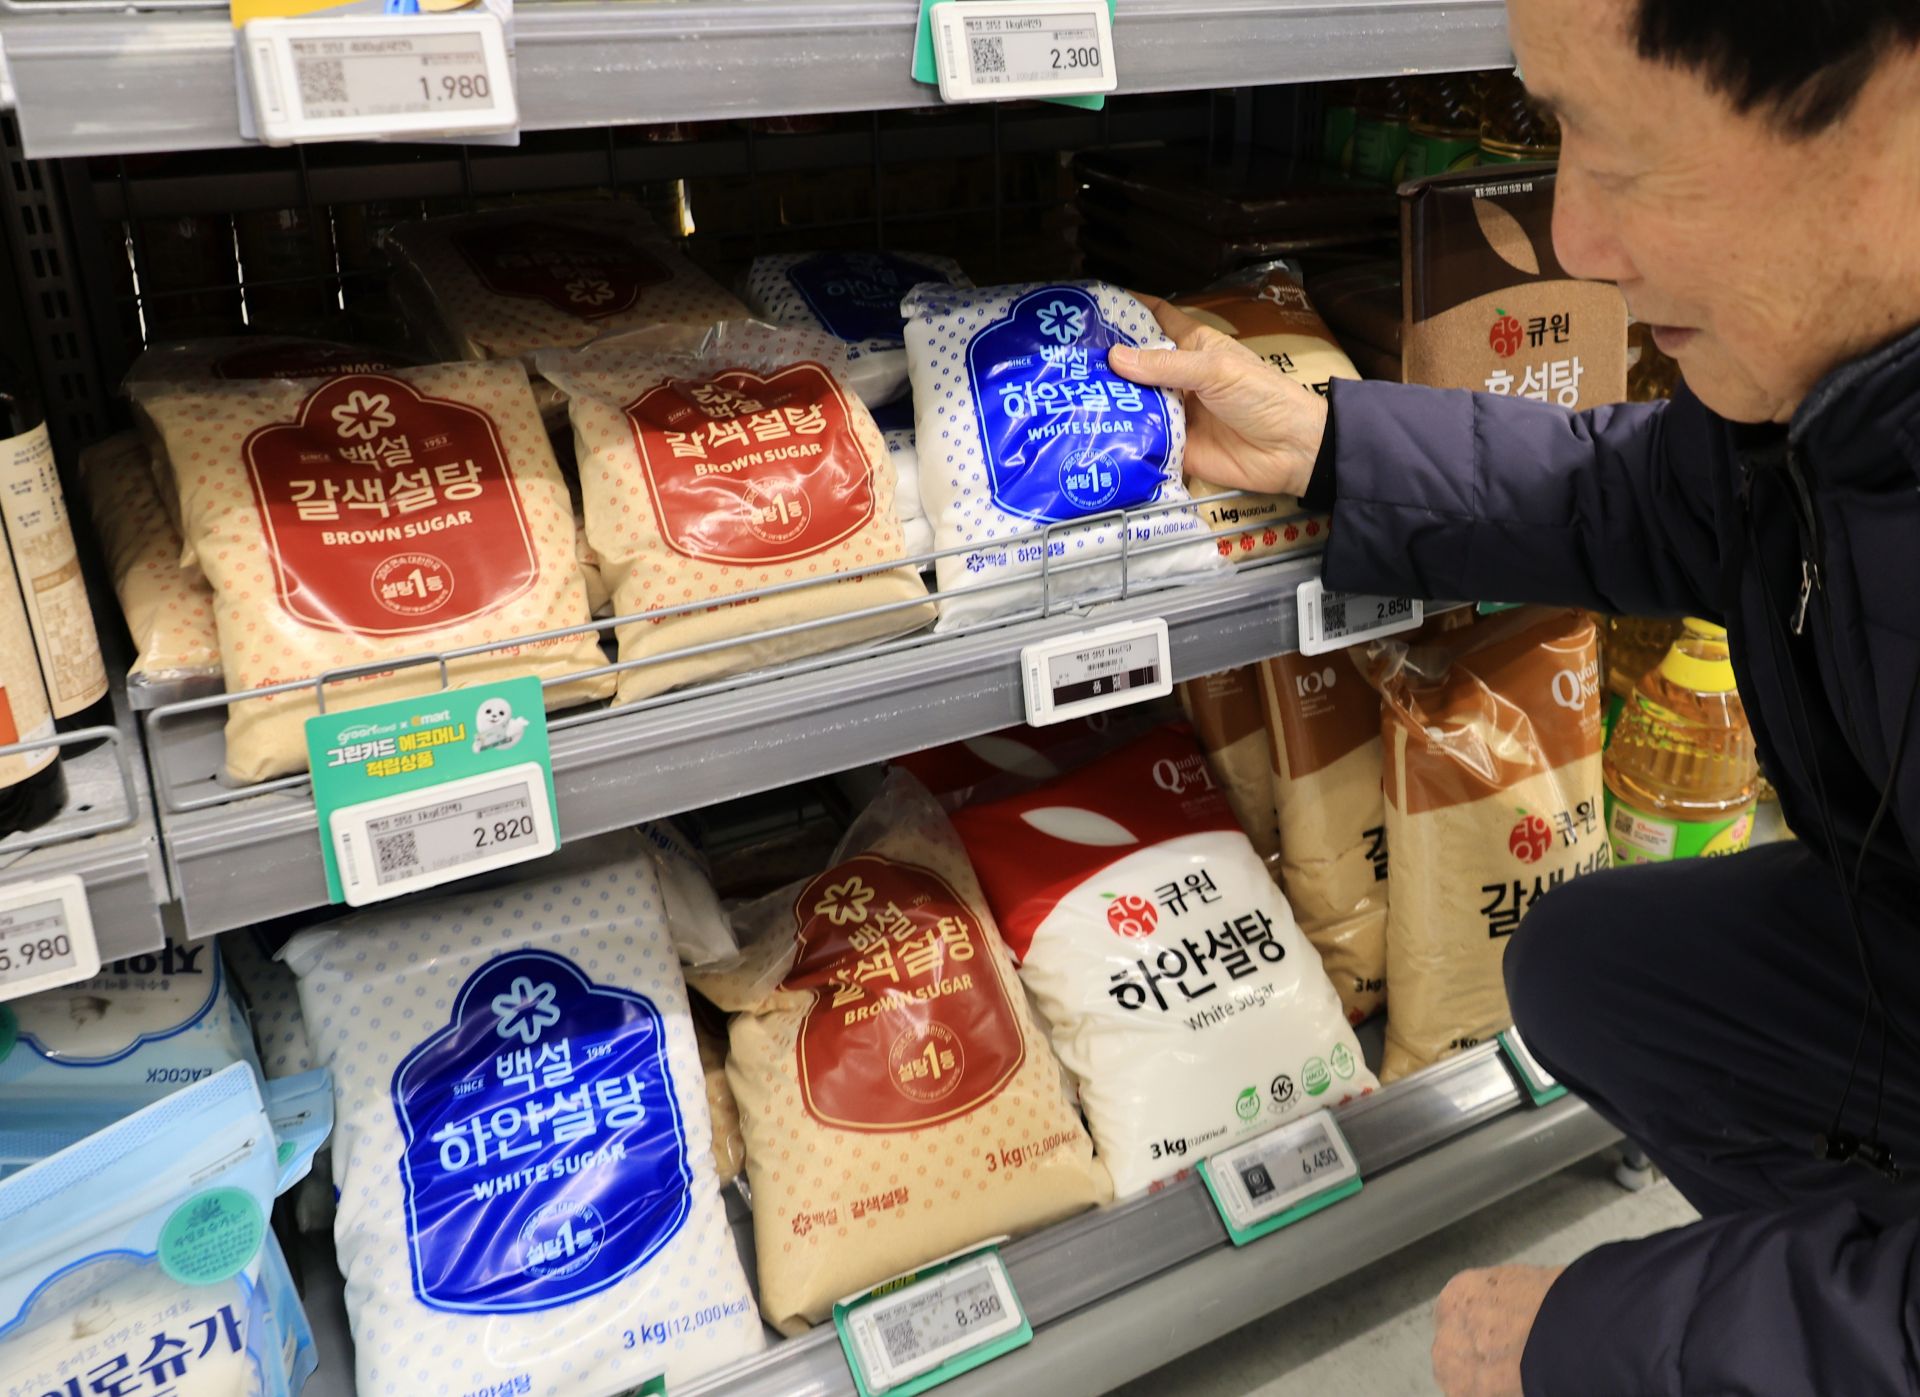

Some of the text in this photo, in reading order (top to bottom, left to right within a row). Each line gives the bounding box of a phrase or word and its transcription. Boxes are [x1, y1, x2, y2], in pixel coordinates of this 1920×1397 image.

[1526, 312, 1570, 347] 큐원
[1008, 358, 1032, 368] SINCE
[1040, 345, 1089, 381] 백설
[999, 380, 1144, 420] 하얀설탕
[424, 436, 448, 449] 1953
[664, 403, 827, 459] 갈색설탕
[1028, 420, 1133, 441] WHITE SUGAR
[338, 434, 414, 473] 백설
[694, 443, 823, 476] BROWN SUGAR
[289, 459, 483, 521] 갈색설탕
[321, 510, 473, 545] BROWN SUGAR
[1136, 527, 1150, 541] kg
[1210, 507, 1239, 524] 1 kg
[985, 551, 1007, 567] 백설
[327, 723, 466, 767] 그린카드 에코머니
[366, 750, 434, 777] 적립상품
[1154, 869, 1223, 917] 큐원
[847, 901, 918, 954] 백설
[829, 916, 975, 1009] 갈색설탕
[1108, 909, 1286, 1012] 하얀설탕
[844, 973, 974, 1027] BROWN SUGAR
[1184, 983, 1276, 1031] White Sugar
[496, 1038, 575, 1093] 백설
[452, 1079, 485, 1096] SINCE
[431, 1074, 646, 1172] 하얀설탕
[985, 1146, 1024, 1173] 3 kg
[1150, 1136, 1188, 1160] 3 kg
[473, 1142, 627, 1201] WHITE SUGAR
[812, 1186, 910, 1226] 백설 갈색설탕
[622, 1322, 668, 1350] 3 kg
